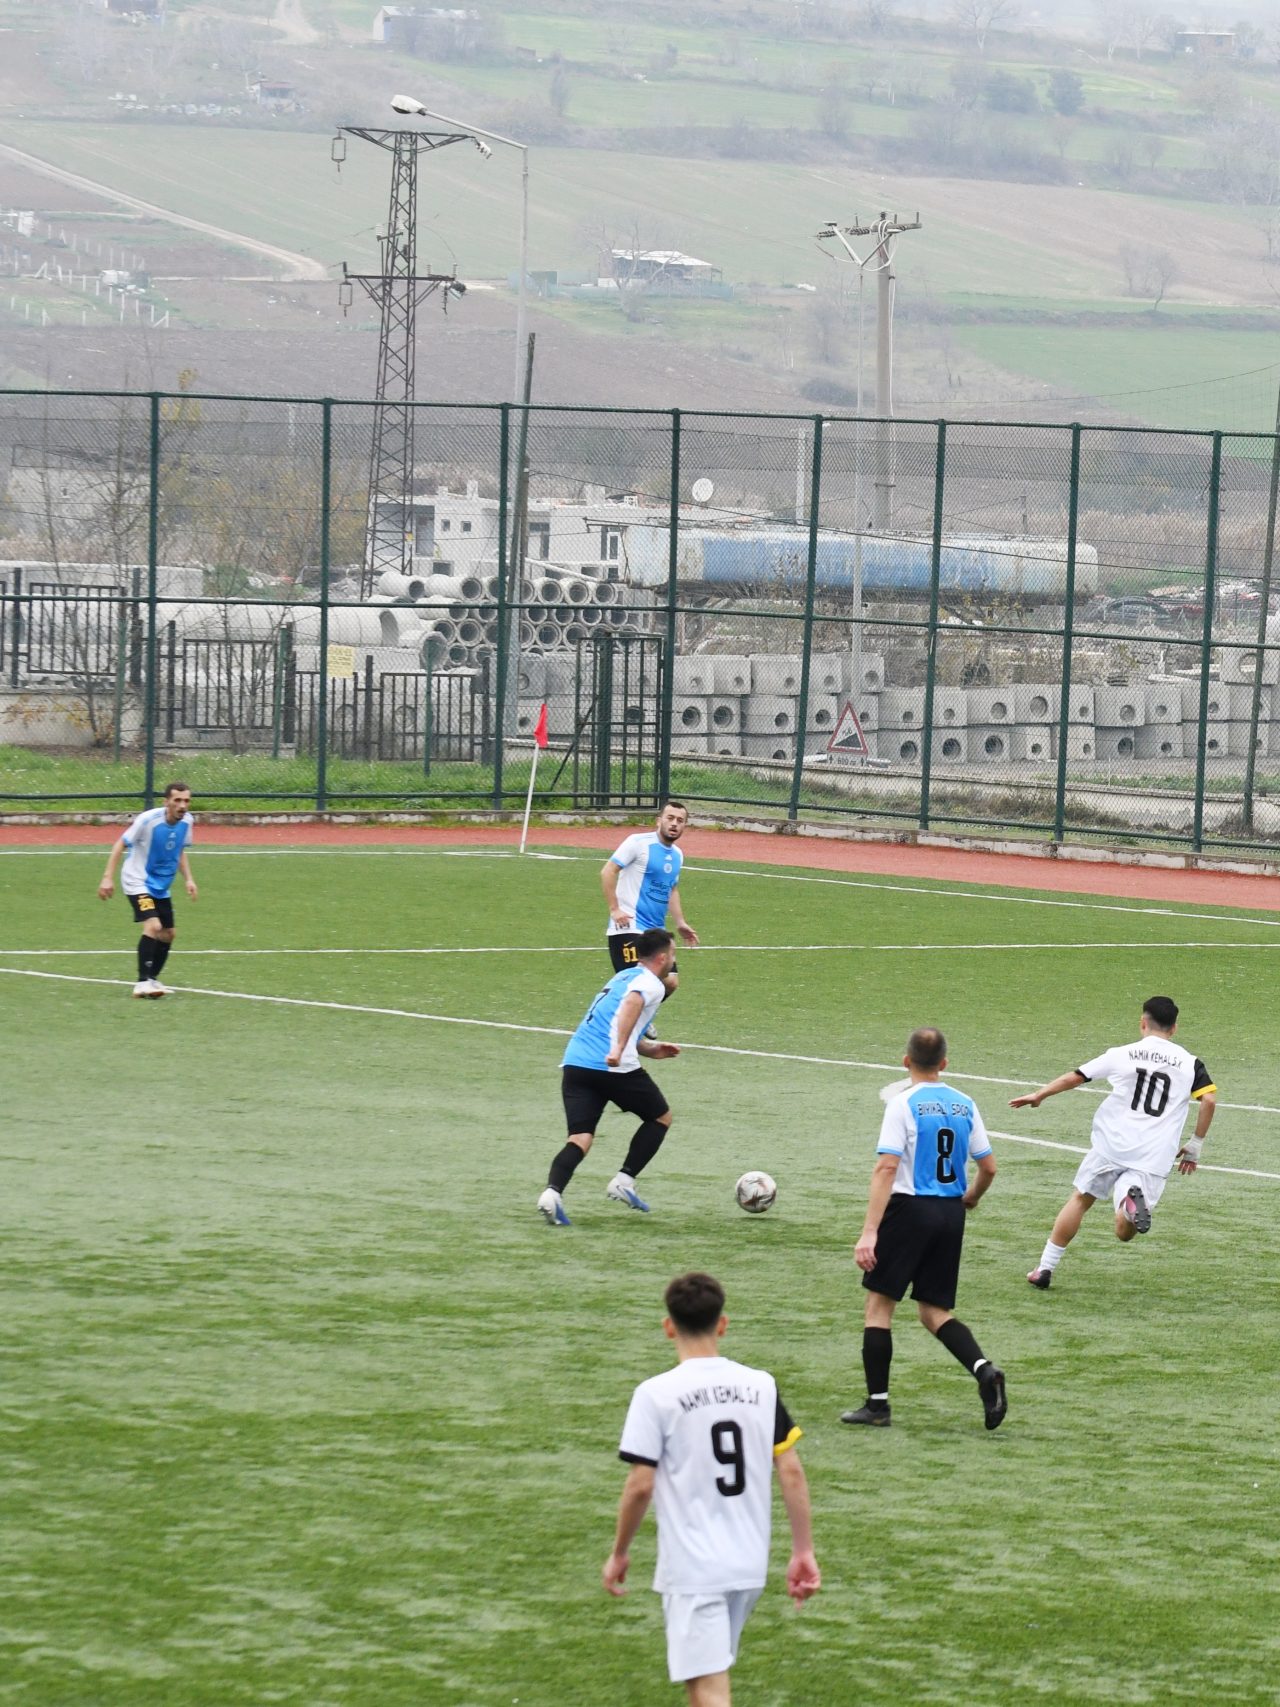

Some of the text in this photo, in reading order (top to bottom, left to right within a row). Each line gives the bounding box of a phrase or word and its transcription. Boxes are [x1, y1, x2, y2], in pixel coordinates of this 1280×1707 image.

[623, 946, 638, 963] 91
[1131, 1067, 1171, 1117] 10
[937, 1128, 957, 1184] 8
[711, 1419, 745, 1496] 9
